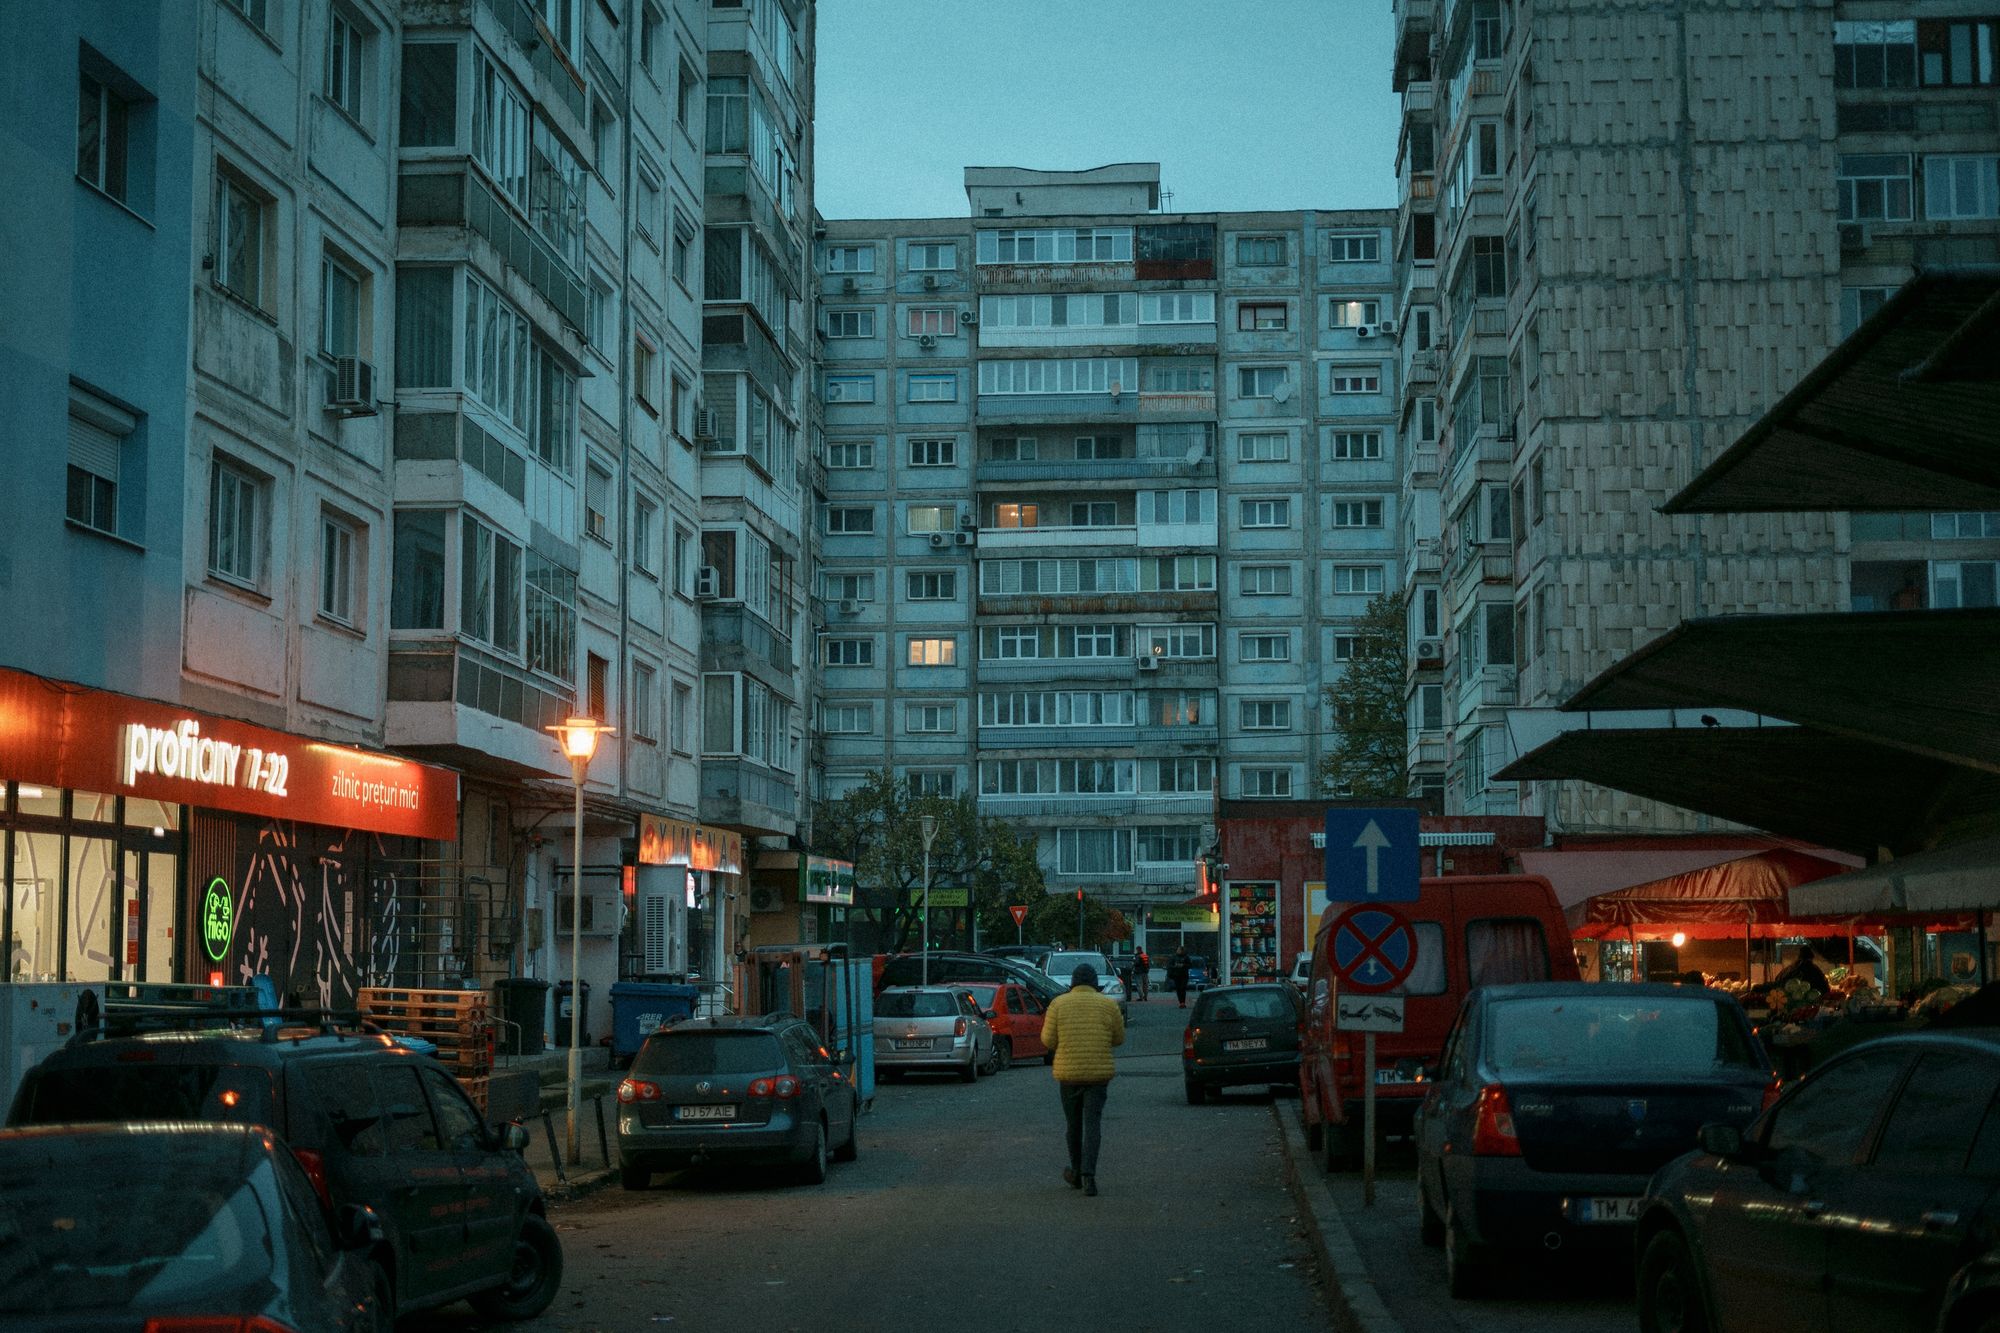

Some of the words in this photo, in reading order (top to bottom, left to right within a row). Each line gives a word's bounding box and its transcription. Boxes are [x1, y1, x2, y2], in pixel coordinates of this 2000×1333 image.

[247, 748, 289, 797] 7-22
[332, 769, 360, 800] zilnic
[399, 783, 419, 810] mici
[1380, 1071, 1396, 1082] TM
[682, 1107, 696, 1118] DJ
[699, 1107, 712, 1117] 57
[1594, 1200, 1618, 1218] TM
